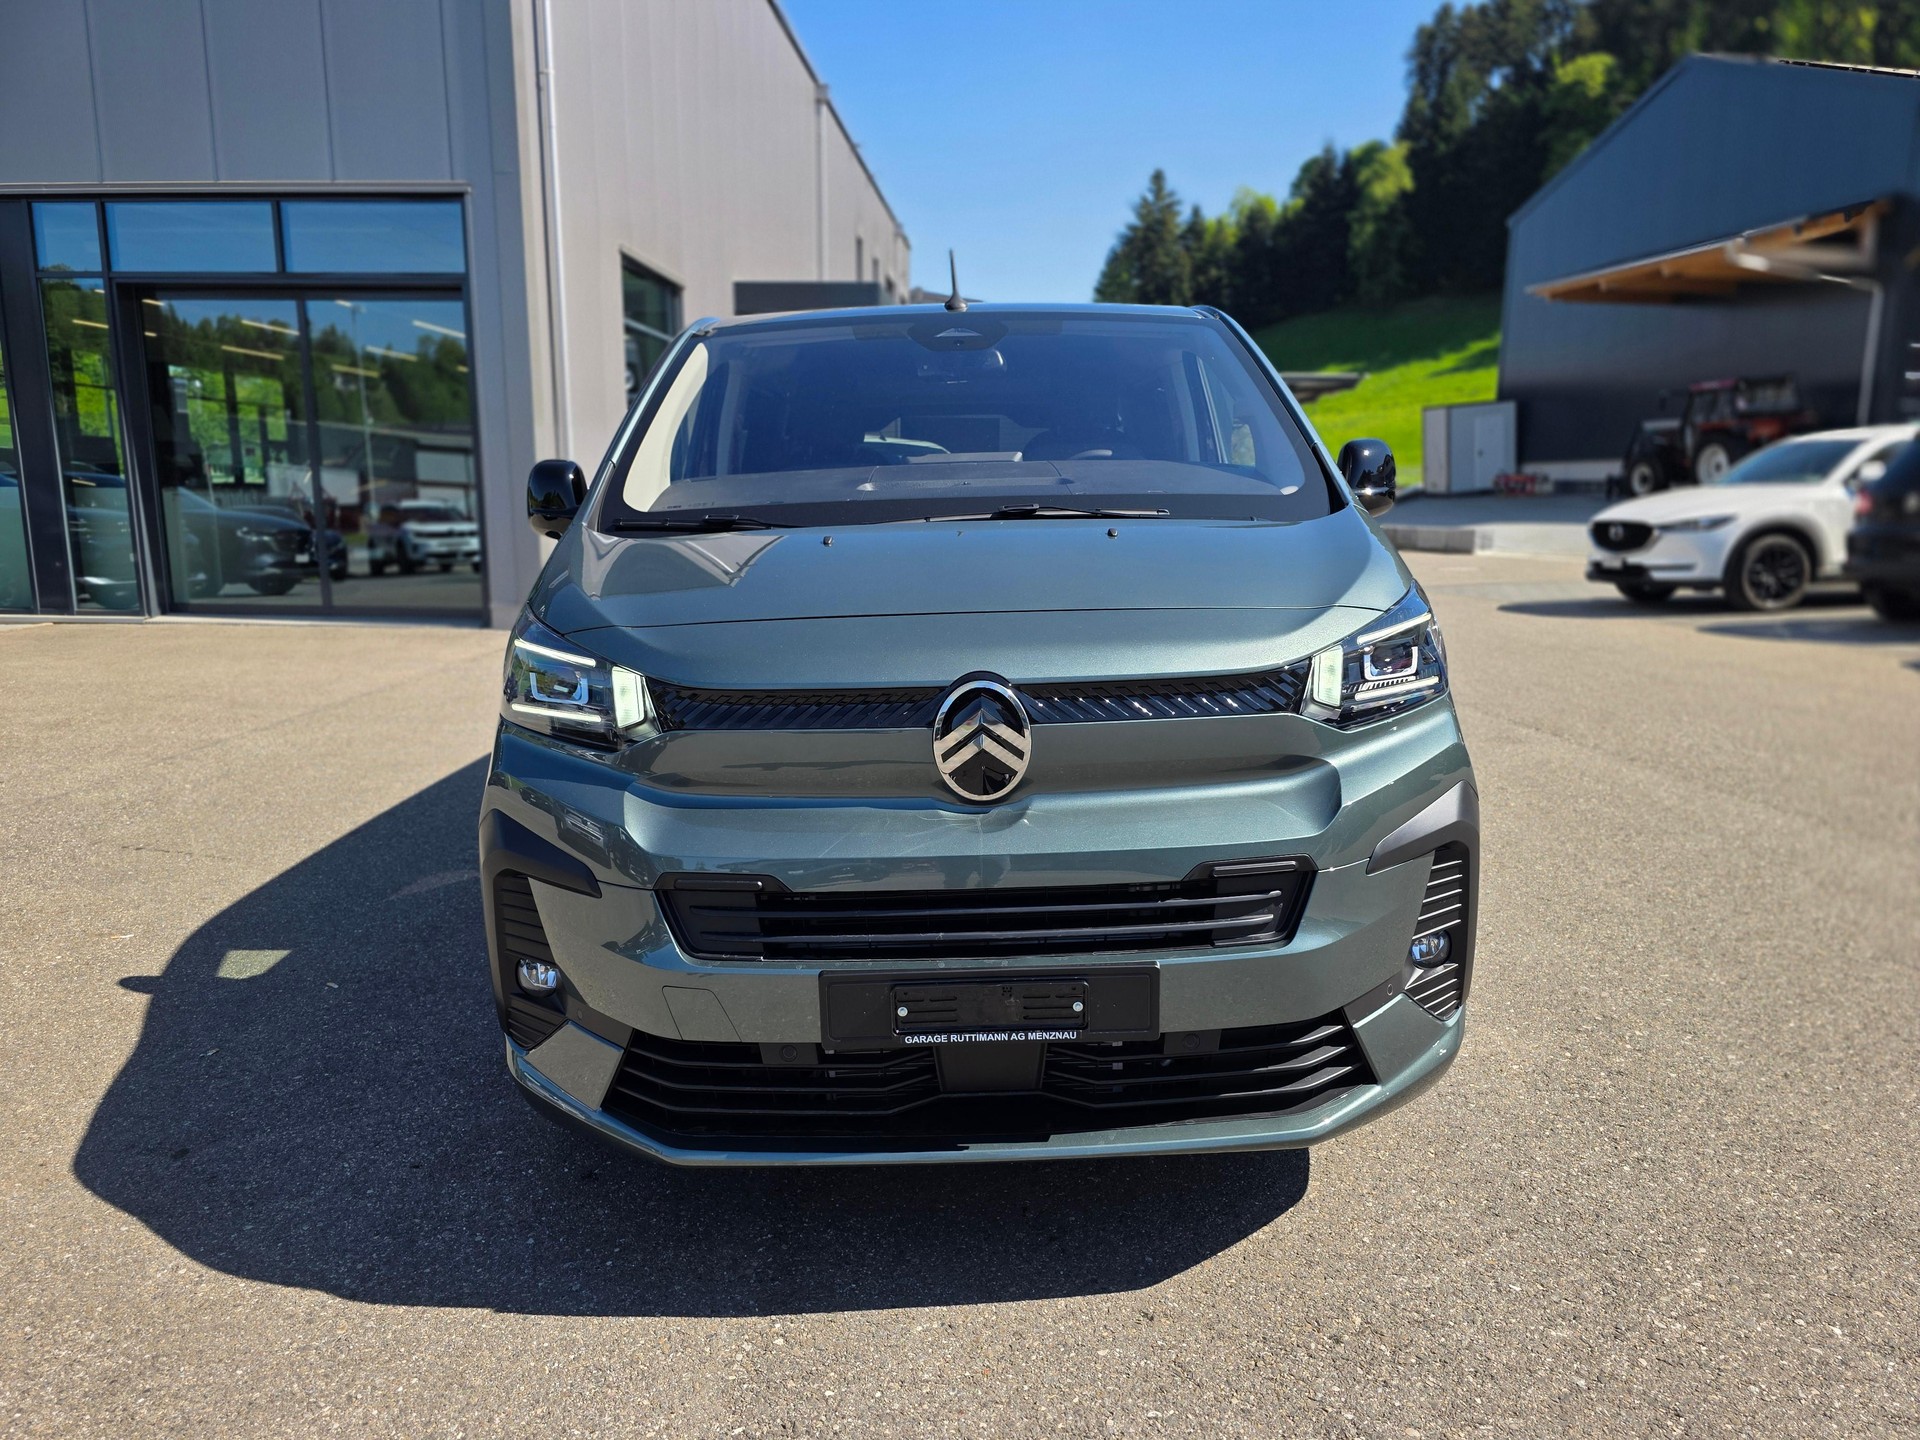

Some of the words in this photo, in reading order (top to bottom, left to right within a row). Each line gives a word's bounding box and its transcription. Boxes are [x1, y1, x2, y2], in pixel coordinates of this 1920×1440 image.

[904, 1034, 948, 1044] GARAGE
[1010, 1032, 1025, 1041] AG
[1028, 1031, 1077, 1041] MENZNAU
